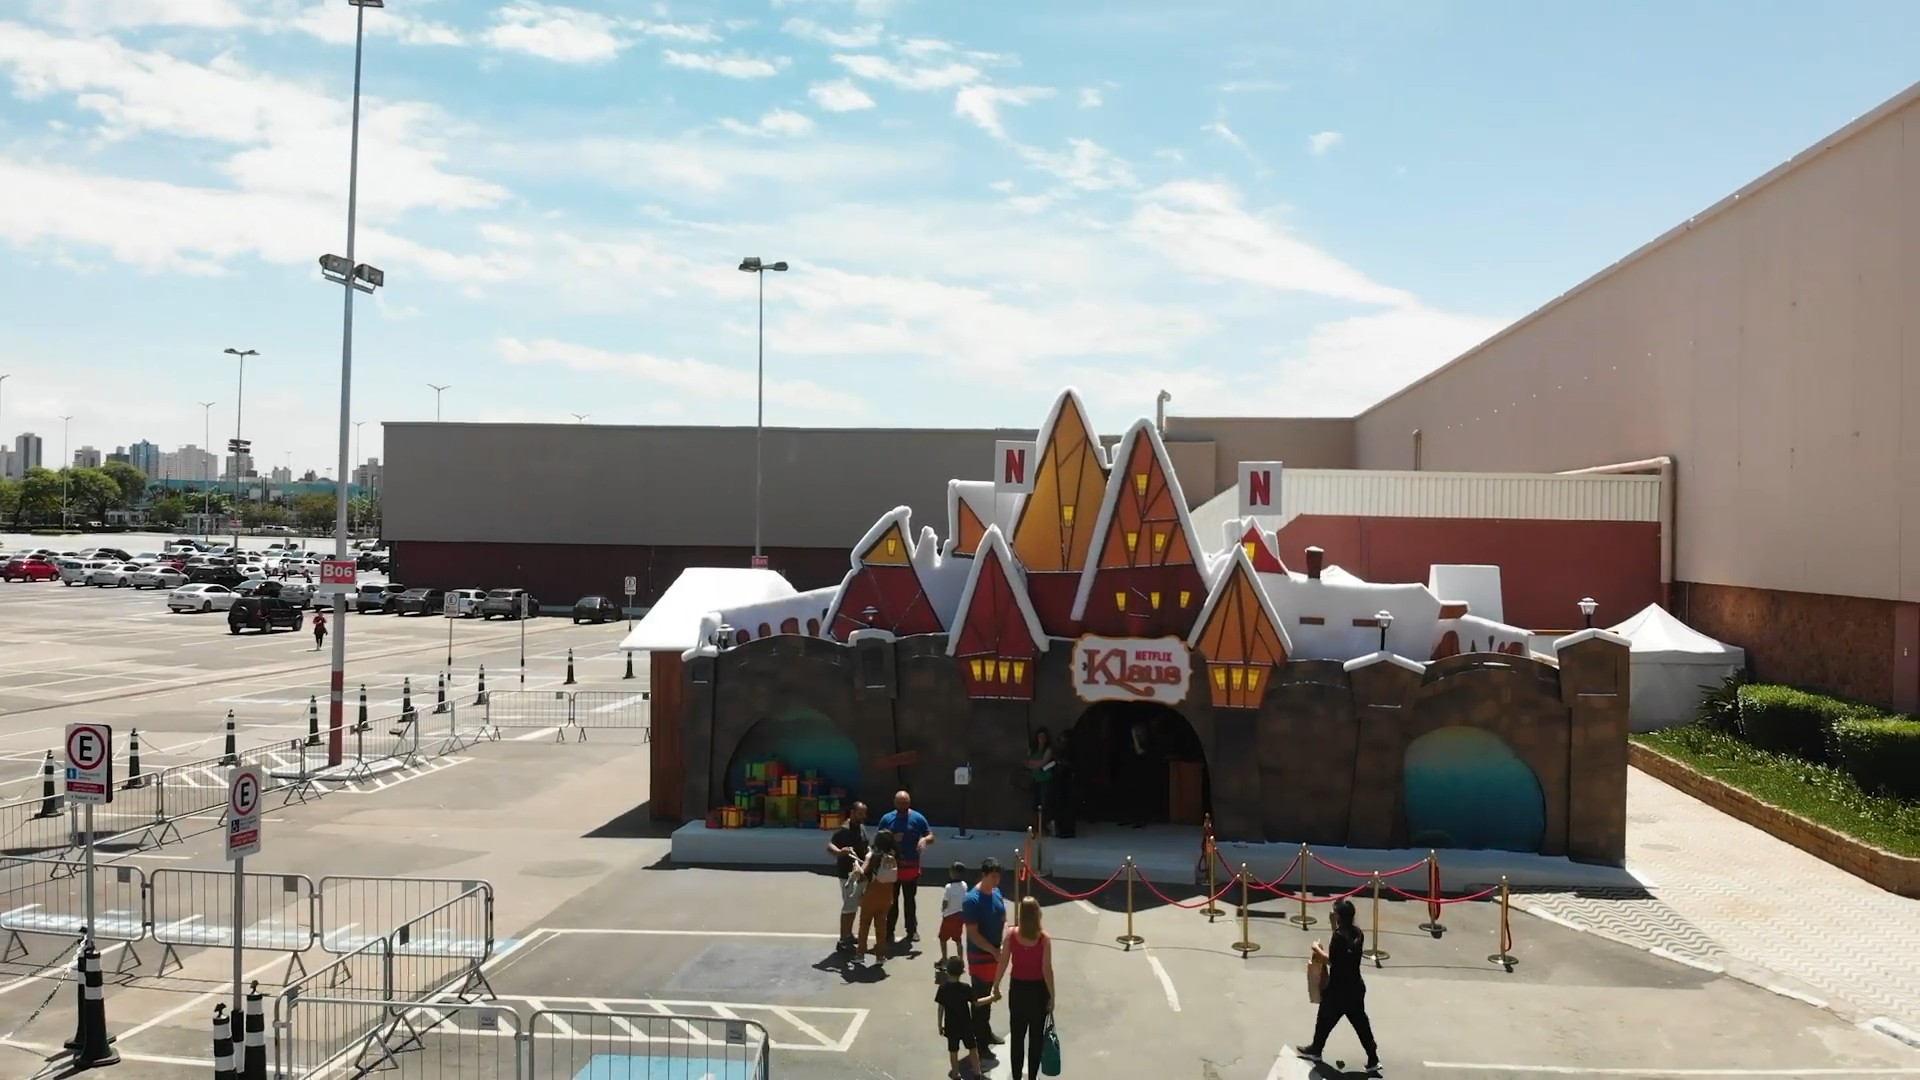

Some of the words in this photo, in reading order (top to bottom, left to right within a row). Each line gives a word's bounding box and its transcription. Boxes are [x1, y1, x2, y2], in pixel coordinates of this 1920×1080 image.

[1005, 449, 1025, 484] N
[1249, 471, 1271, 506] N
[323, 563, 353, 578] B06
[1135, 650, 1173, 662] NETFLIX
[1082, 648, 1182, 697] Klaus
[79, 735, 93, 762] E
[240, 781, 250, 807] E
